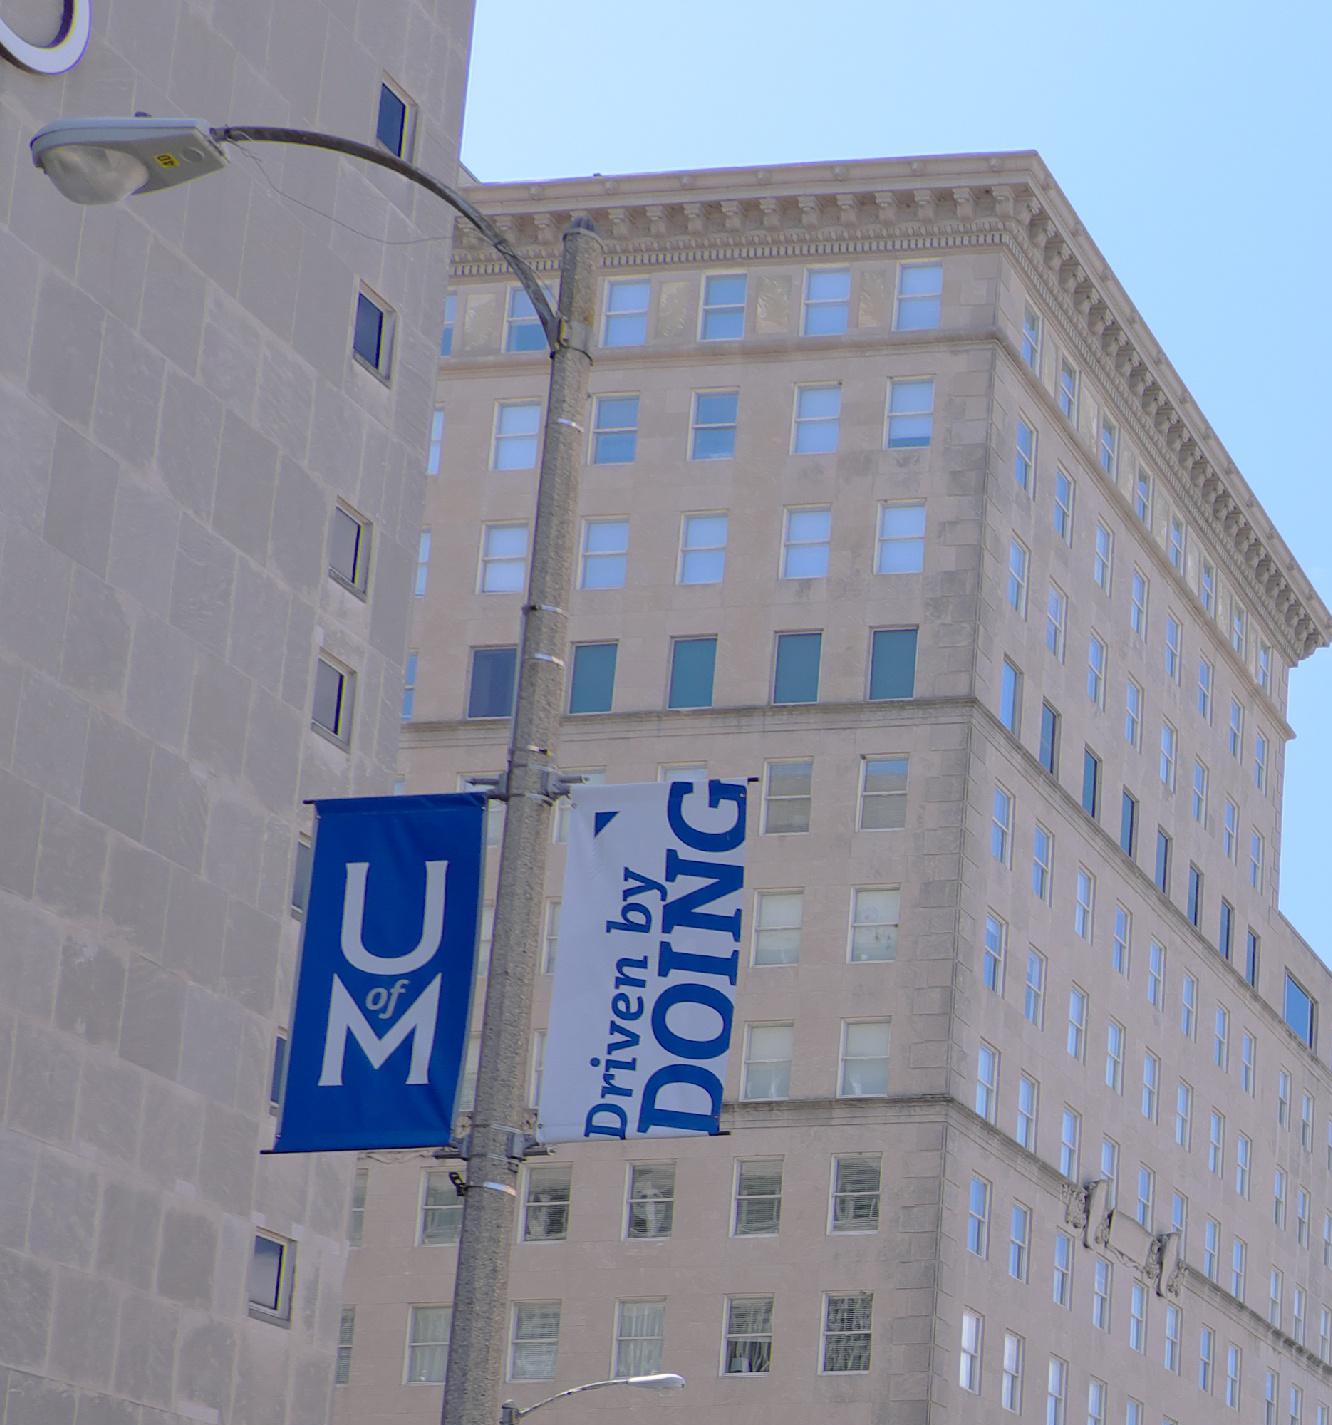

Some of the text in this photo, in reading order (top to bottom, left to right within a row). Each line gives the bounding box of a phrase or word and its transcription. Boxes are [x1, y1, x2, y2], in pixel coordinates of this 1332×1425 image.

[341, 860, 448, 975] U
[638, 779, 748, 1136] DOING
[318, 972, 442, 1086] M
[365, 979, 410, 1020] of
[584, 867, 668, 1140] Driven by
